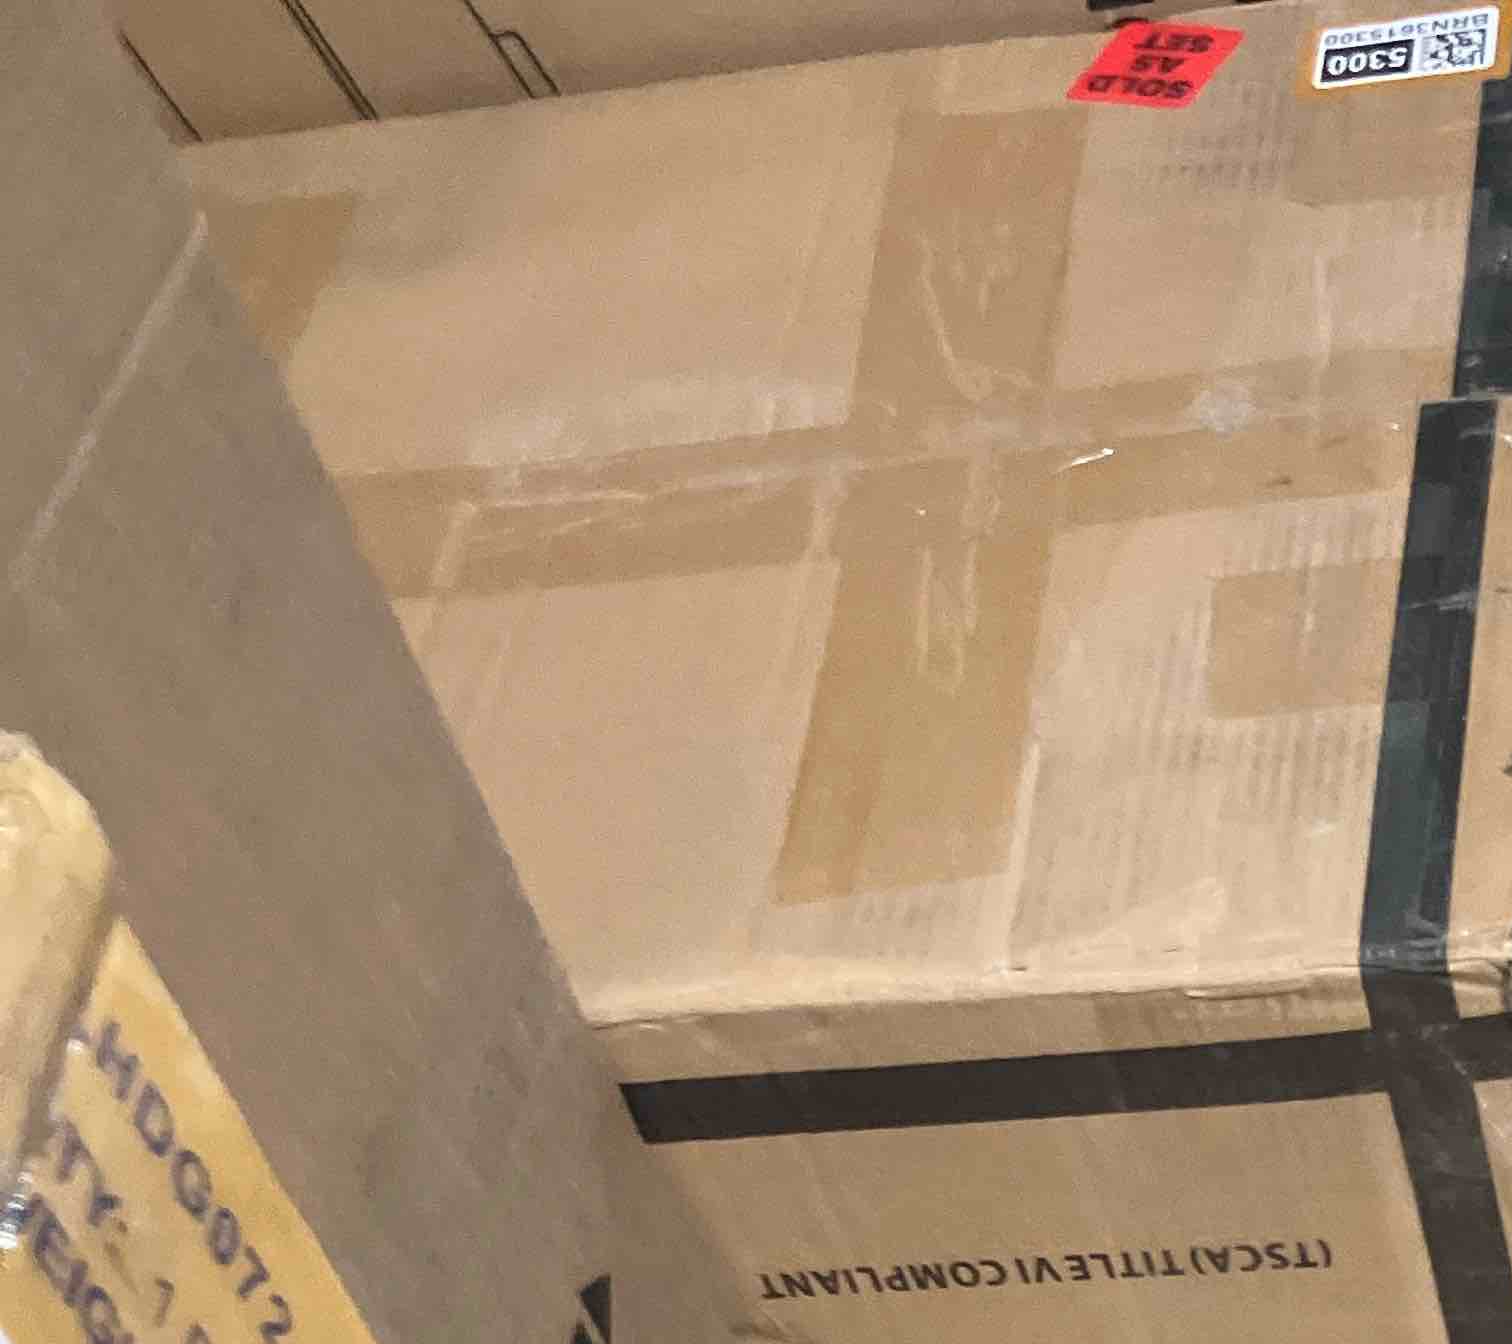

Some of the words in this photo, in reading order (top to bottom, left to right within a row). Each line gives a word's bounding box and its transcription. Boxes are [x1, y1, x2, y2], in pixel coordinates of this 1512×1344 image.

[1135, 33, 1213, 53] SET
[1131, 55, 1186, 73] AS
[1327, 47, 1408, 76] 5300
[1087, 75, 1193, 98] SOLD
[1014, 1254, 1059, 1285] VI
[1065, 1246, 1184, 1280] TITLE
[1198, 1239, 1332, 1276] (TSCA)
[757, 1256, 1010, 1300] COMPLIANT
